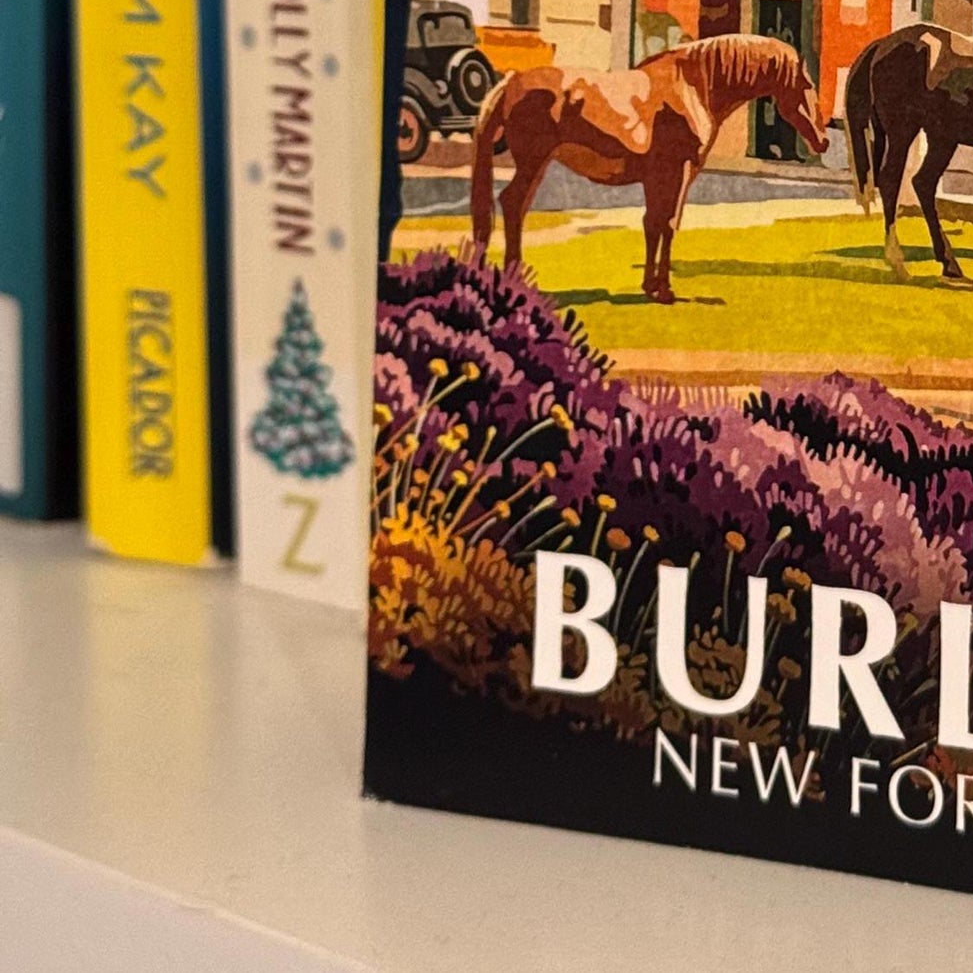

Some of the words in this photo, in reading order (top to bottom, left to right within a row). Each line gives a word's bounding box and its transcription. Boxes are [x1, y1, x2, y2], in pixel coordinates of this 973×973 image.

[122, 53, 167, 199] KAY
[271, 84, 316, 257] MARTIN
[128, 288, 173, 480] PICADOR
[652, 728, 818, 806] NEW
